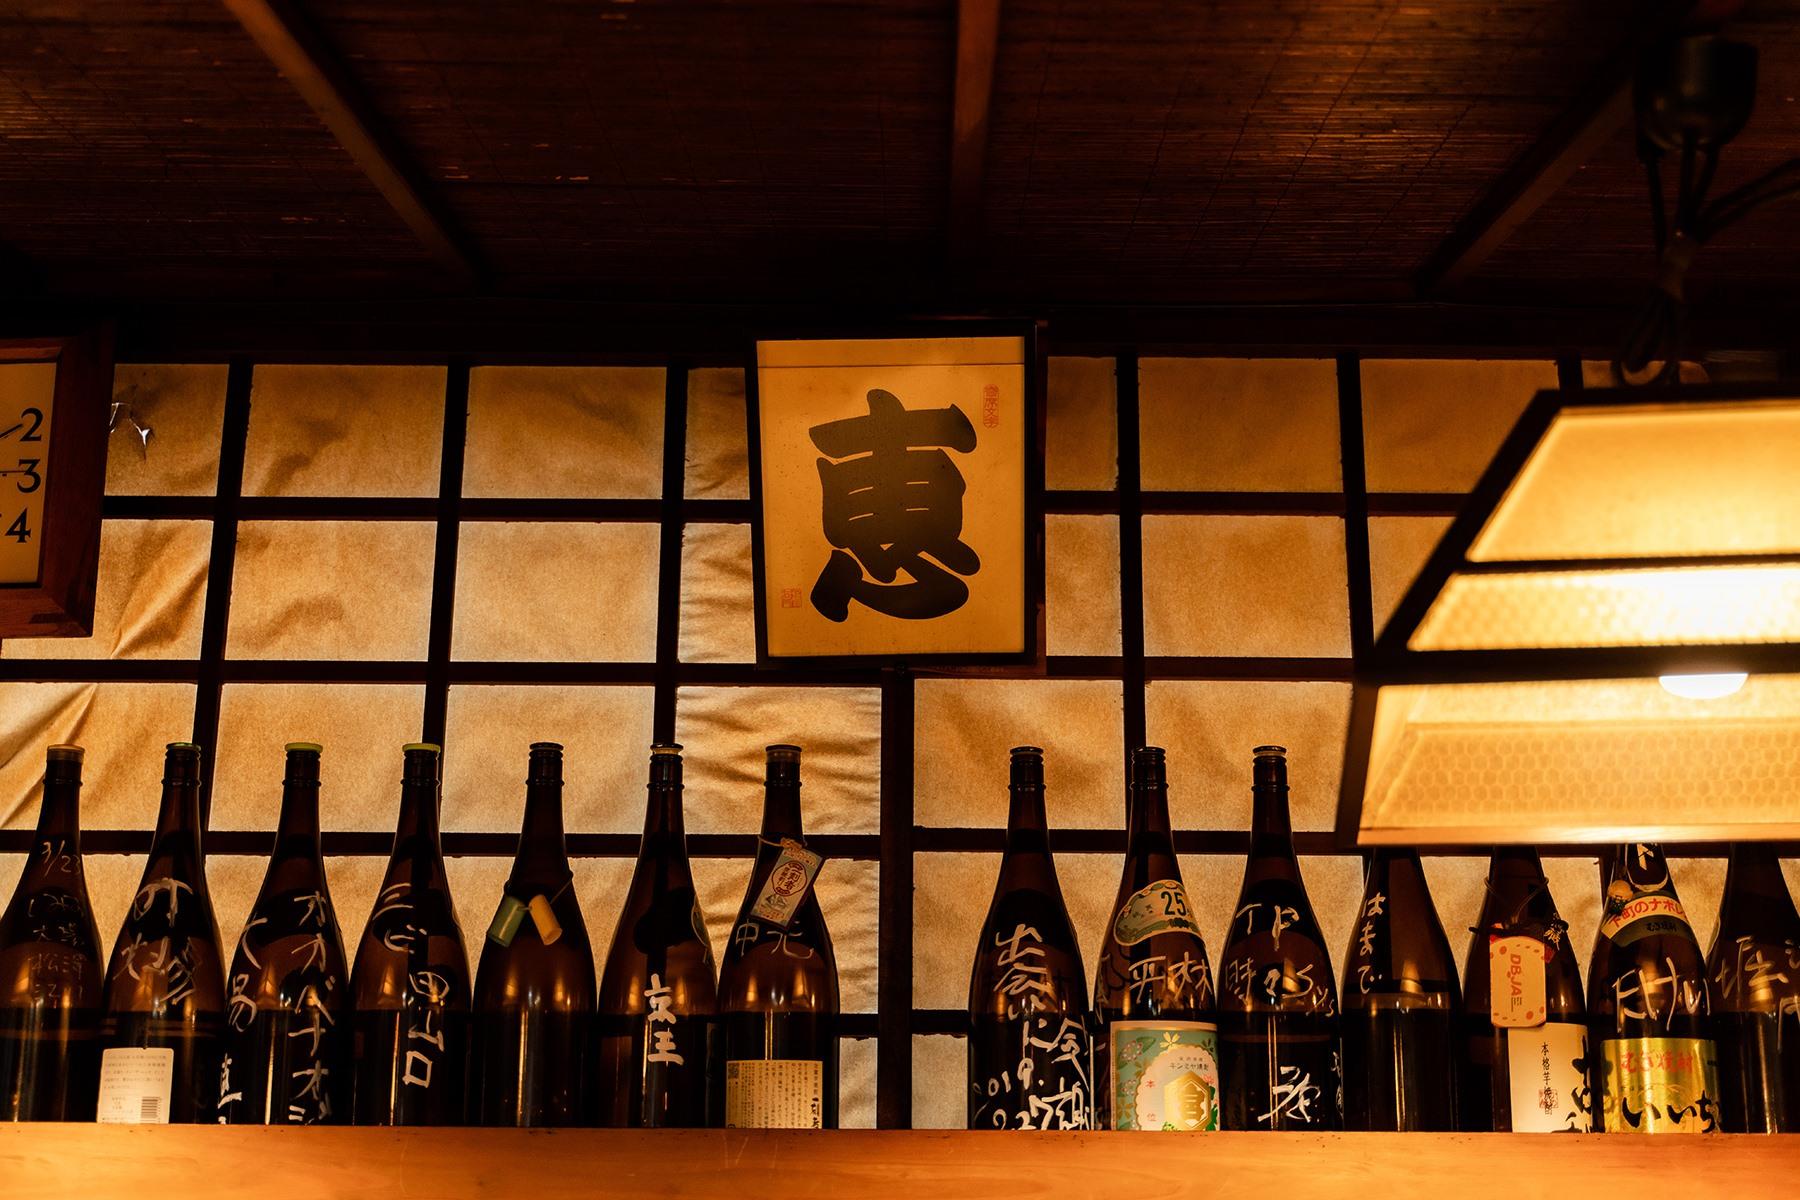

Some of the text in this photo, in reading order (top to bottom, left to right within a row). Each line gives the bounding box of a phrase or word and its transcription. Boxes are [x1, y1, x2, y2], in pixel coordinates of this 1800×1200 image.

[21, 408, 43, 442] 2
[17, 459, 41, 493] 3
[5, 508, 31, 543] 4
[1160, 891, 1187, 916] 25
